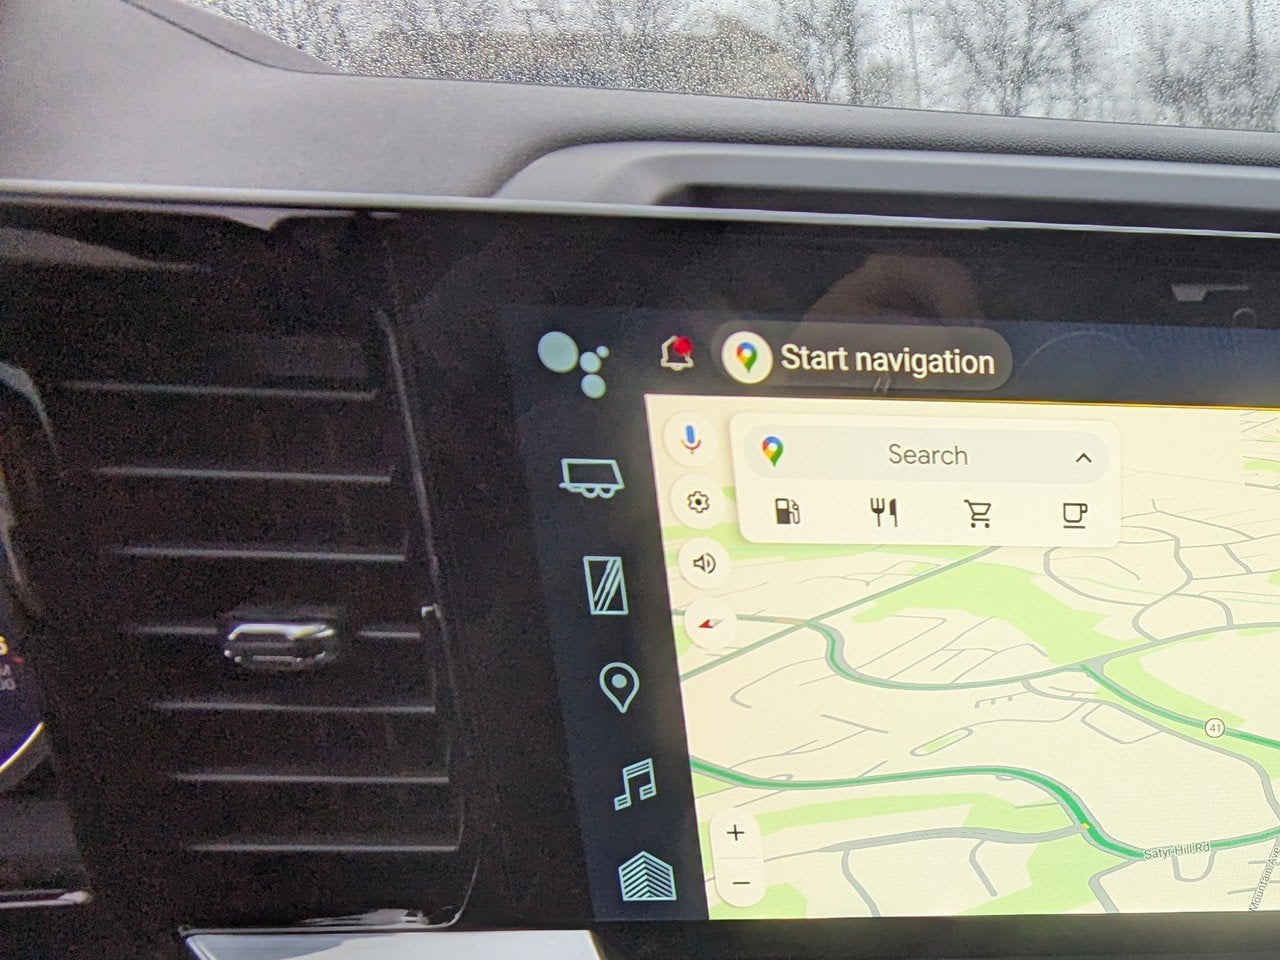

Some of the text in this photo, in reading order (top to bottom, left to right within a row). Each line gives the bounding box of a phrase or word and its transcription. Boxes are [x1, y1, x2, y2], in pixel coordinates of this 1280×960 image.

[781, 343, 995, 379] Start navigation
[889, 443, 968, 466] Search
[1210, 723, 1221, 733] 41
[1144, 842, 1210, 861] Satyr Hill Rd
[1249, 863, 1274, 911] Mountain
